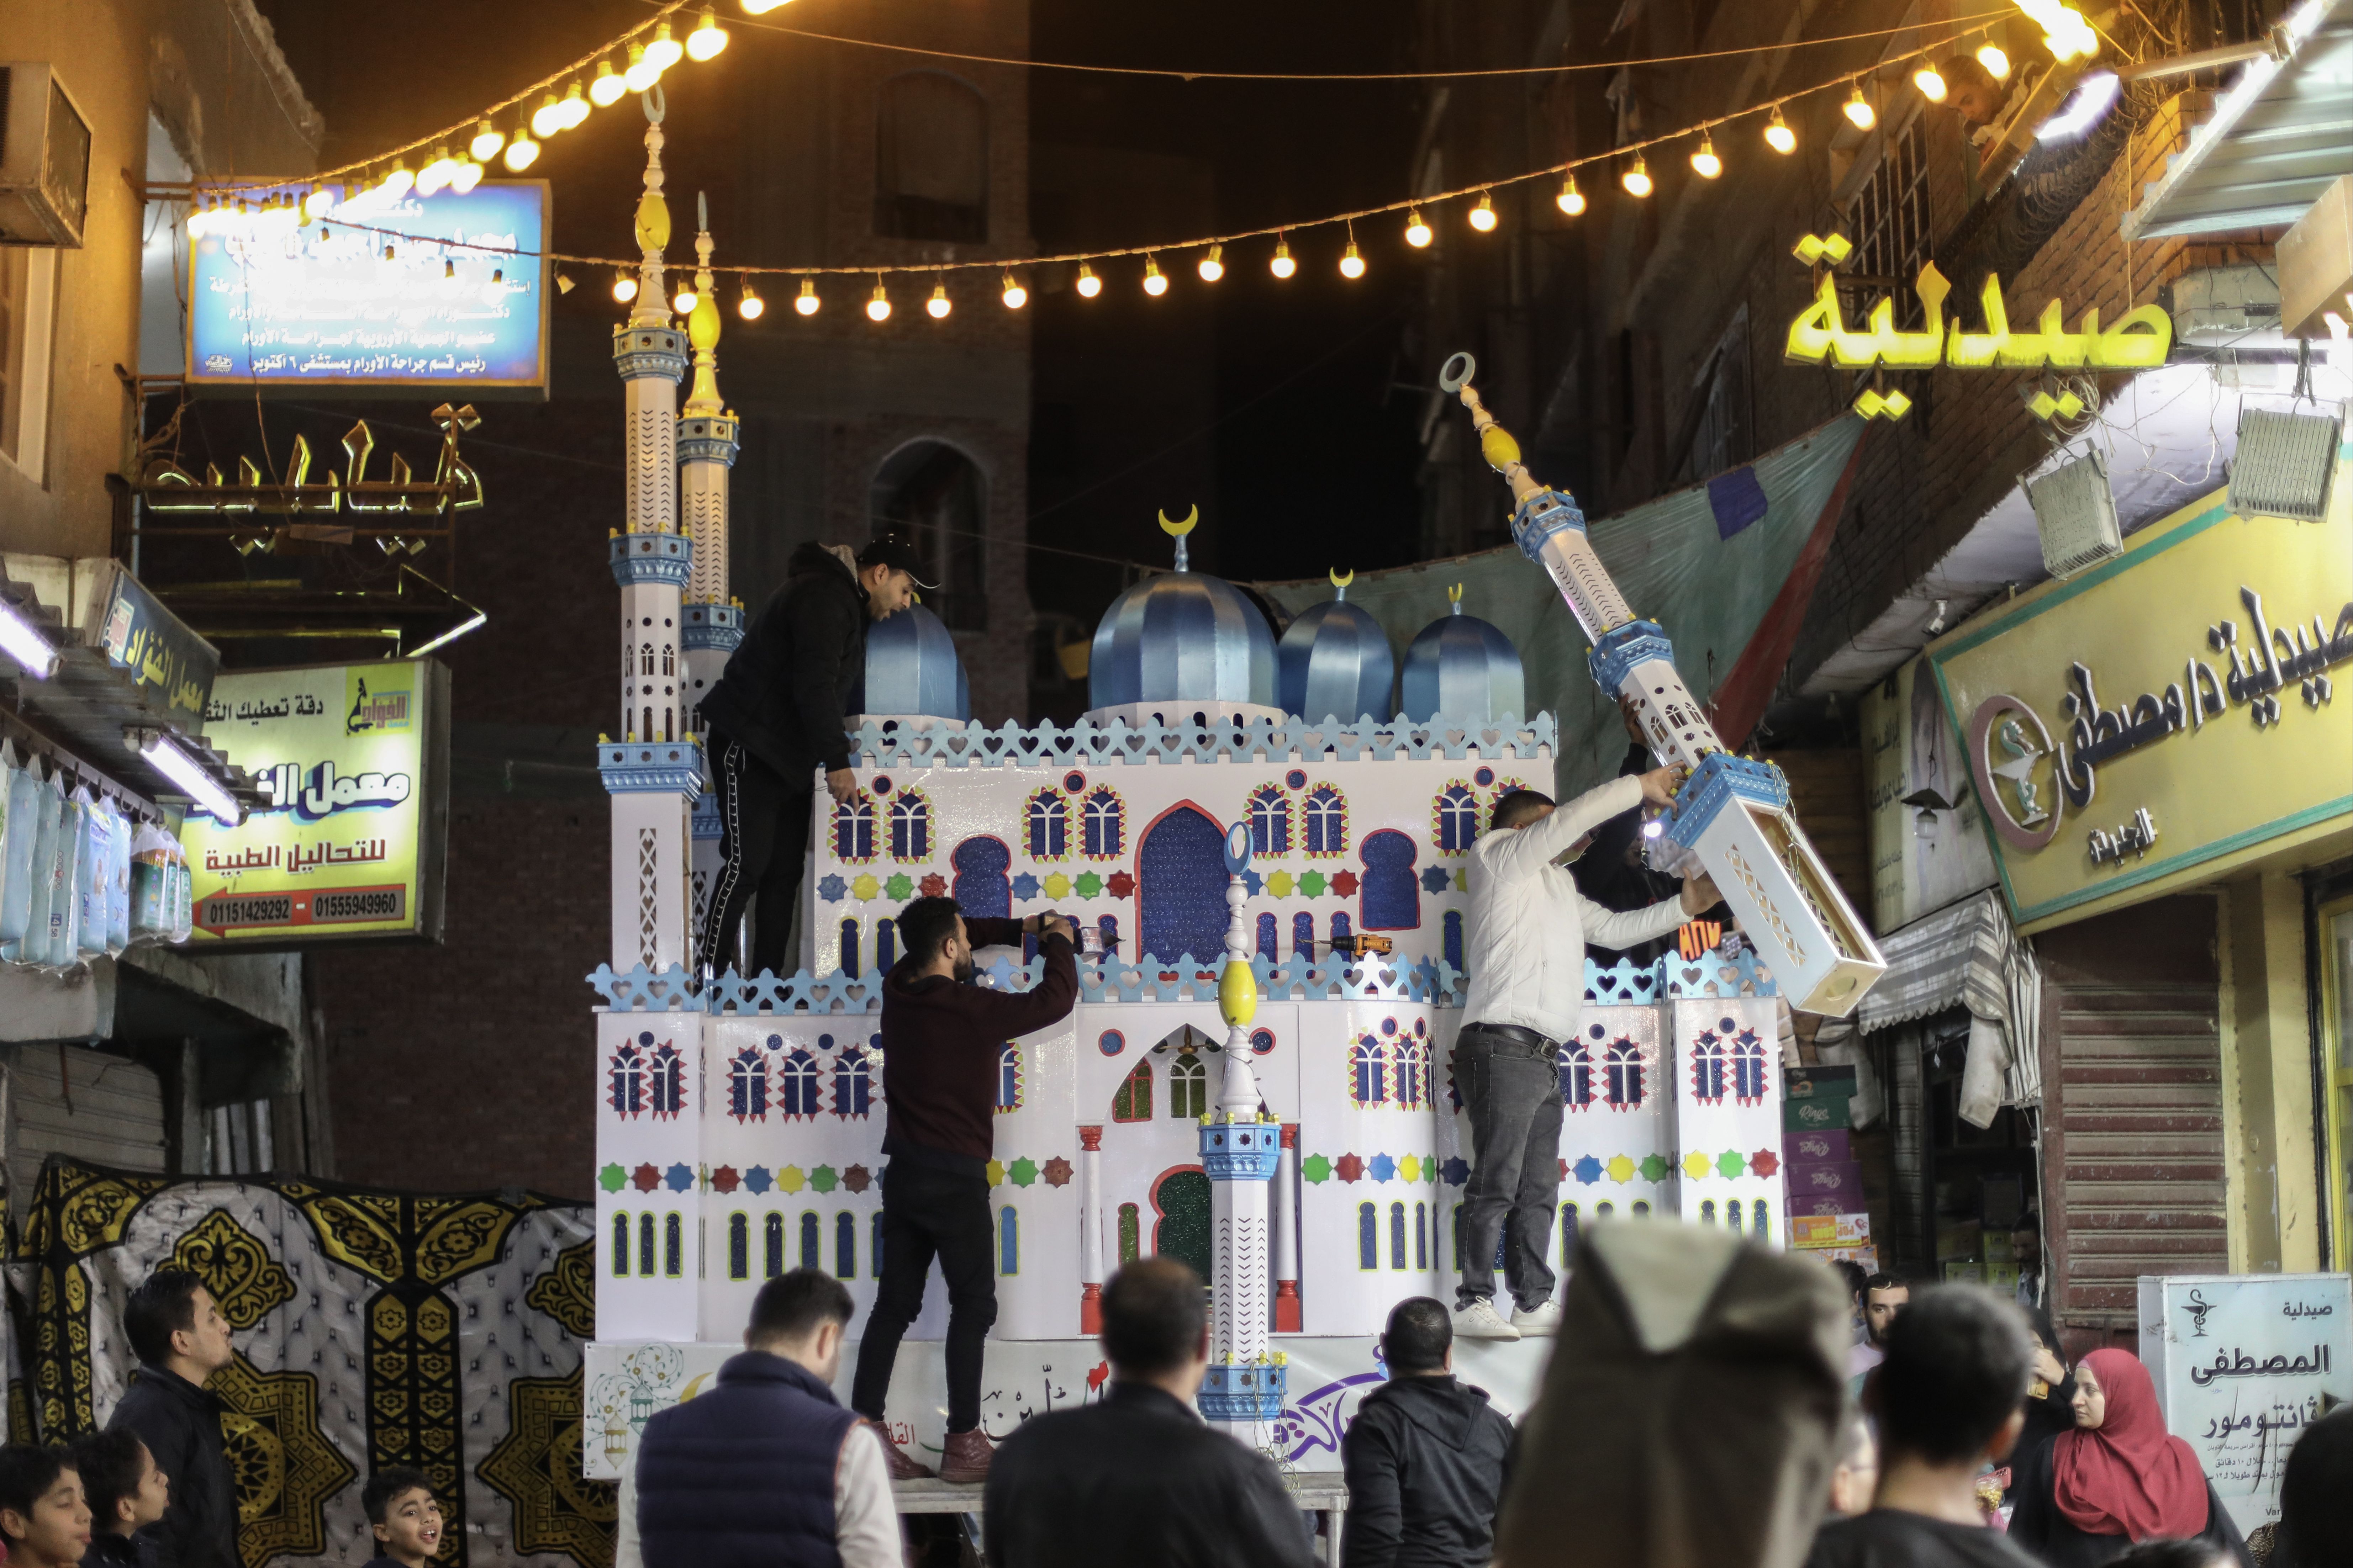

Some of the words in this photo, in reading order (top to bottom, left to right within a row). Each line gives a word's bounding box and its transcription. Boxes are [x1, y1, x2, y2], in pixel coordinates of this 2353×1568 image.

[1785, 233, 2172, 421] صيدلية
[252, 353, 286, 374] أكتوبر
[300, 353, 352, 374] بمستشفى
[354, 353, 389, 373] الأورام
[391, 354, 427, 373] جراحة
[429, 354, 455, 374] قسم
[456, 354, 486, 374] رئيس
[125, 627, 174, 686] الفؤاد
[2209, 585, 2353, 728] صيدلية
[169, 661, 203, 713] معمل
[237, 698, 289, 725] تعطيك
[295, 695, 323, 715] دقة
[305, 761, 410, 814] معمل
[206, 845, 280, 876] الطبية
[287, 839, 385, 872] للتحاليل
[210, 899, 289, 924] 01151429292
[316, 893, 396, 917] 01555949960
[2283, 1301, 2332, 1321] صيدلية
[2191, 1344, 2331, 1386] المصطفى
[2215, 1458, 2236, 1468] دقائق
[2230, 1471, 2251, 1480] طويلا
